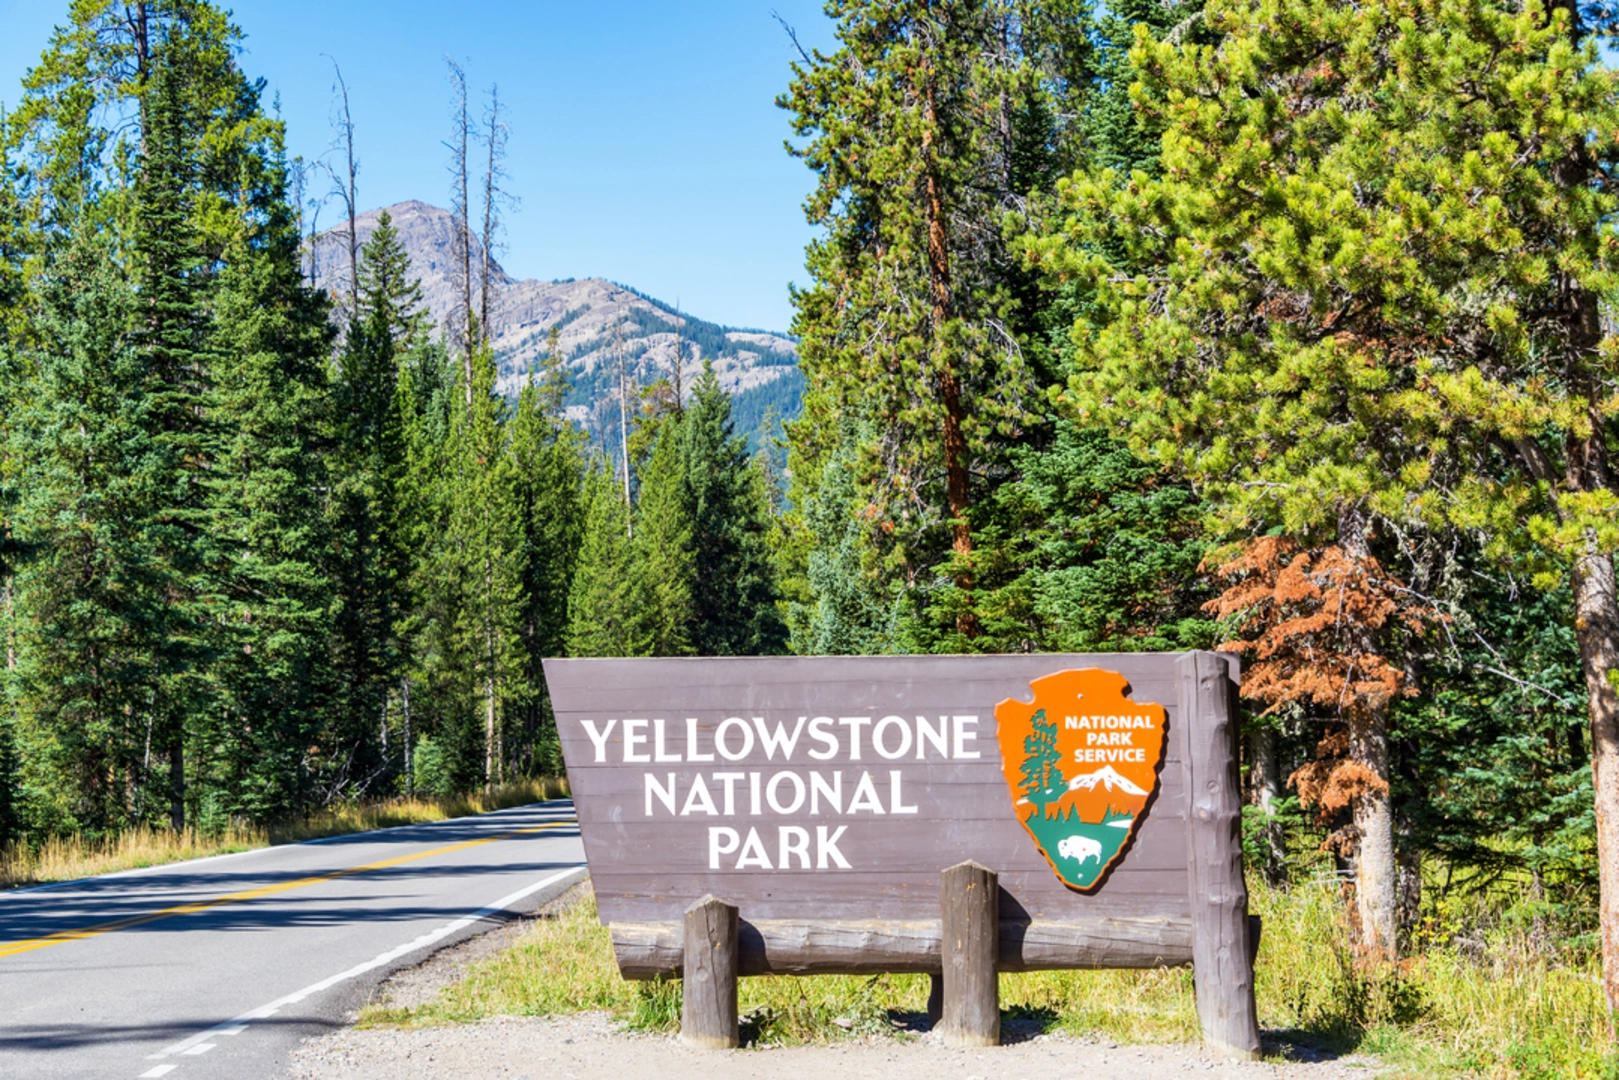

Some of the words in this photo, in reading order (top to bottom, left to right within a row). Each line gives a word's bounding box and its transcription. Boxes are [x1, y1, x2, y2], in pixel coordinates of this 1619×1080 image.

[1064, 715, 1155, 729] NATIONAL
[579, 714, 982, 764] YELLOWSTONE
[1086, 732, 1133, 746] PARK
[1074, 749, 1146, 763] SERVICE
[643, 769, 920, 818] NATIONAL
[707, 824, 853, 870] PARK
